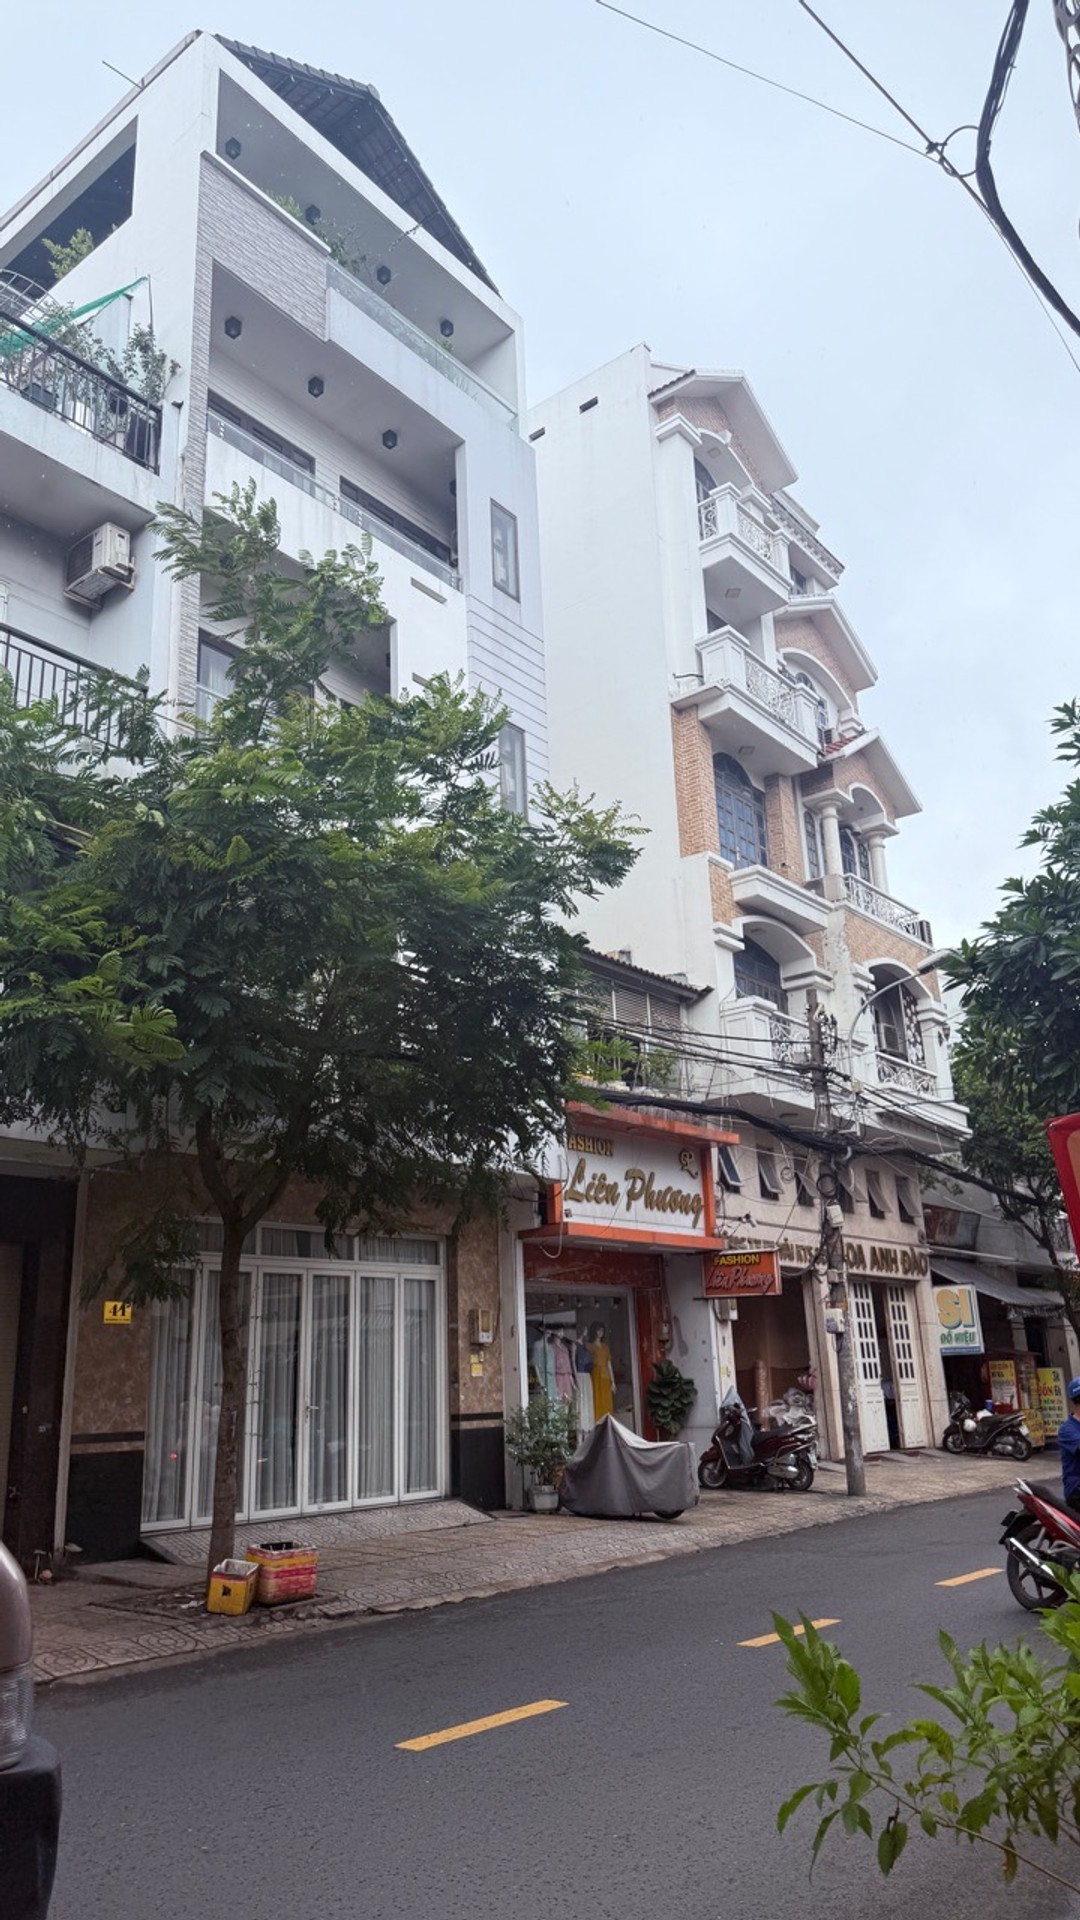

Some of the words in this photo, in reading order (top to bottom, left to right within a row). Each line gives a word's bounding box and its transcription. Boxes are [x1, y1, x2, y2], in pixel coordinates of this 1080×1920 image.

[567, 1134, 615, 1157] ASHION
[564, 1158, 620, 1206] Liên
[714, 1254, 760, 1266] FASHION
[844, 1242, 867, 1272] OA
[870, 1245, 900, 1275] ANH
[900, 1246, 929, 1277] ĐÀO
